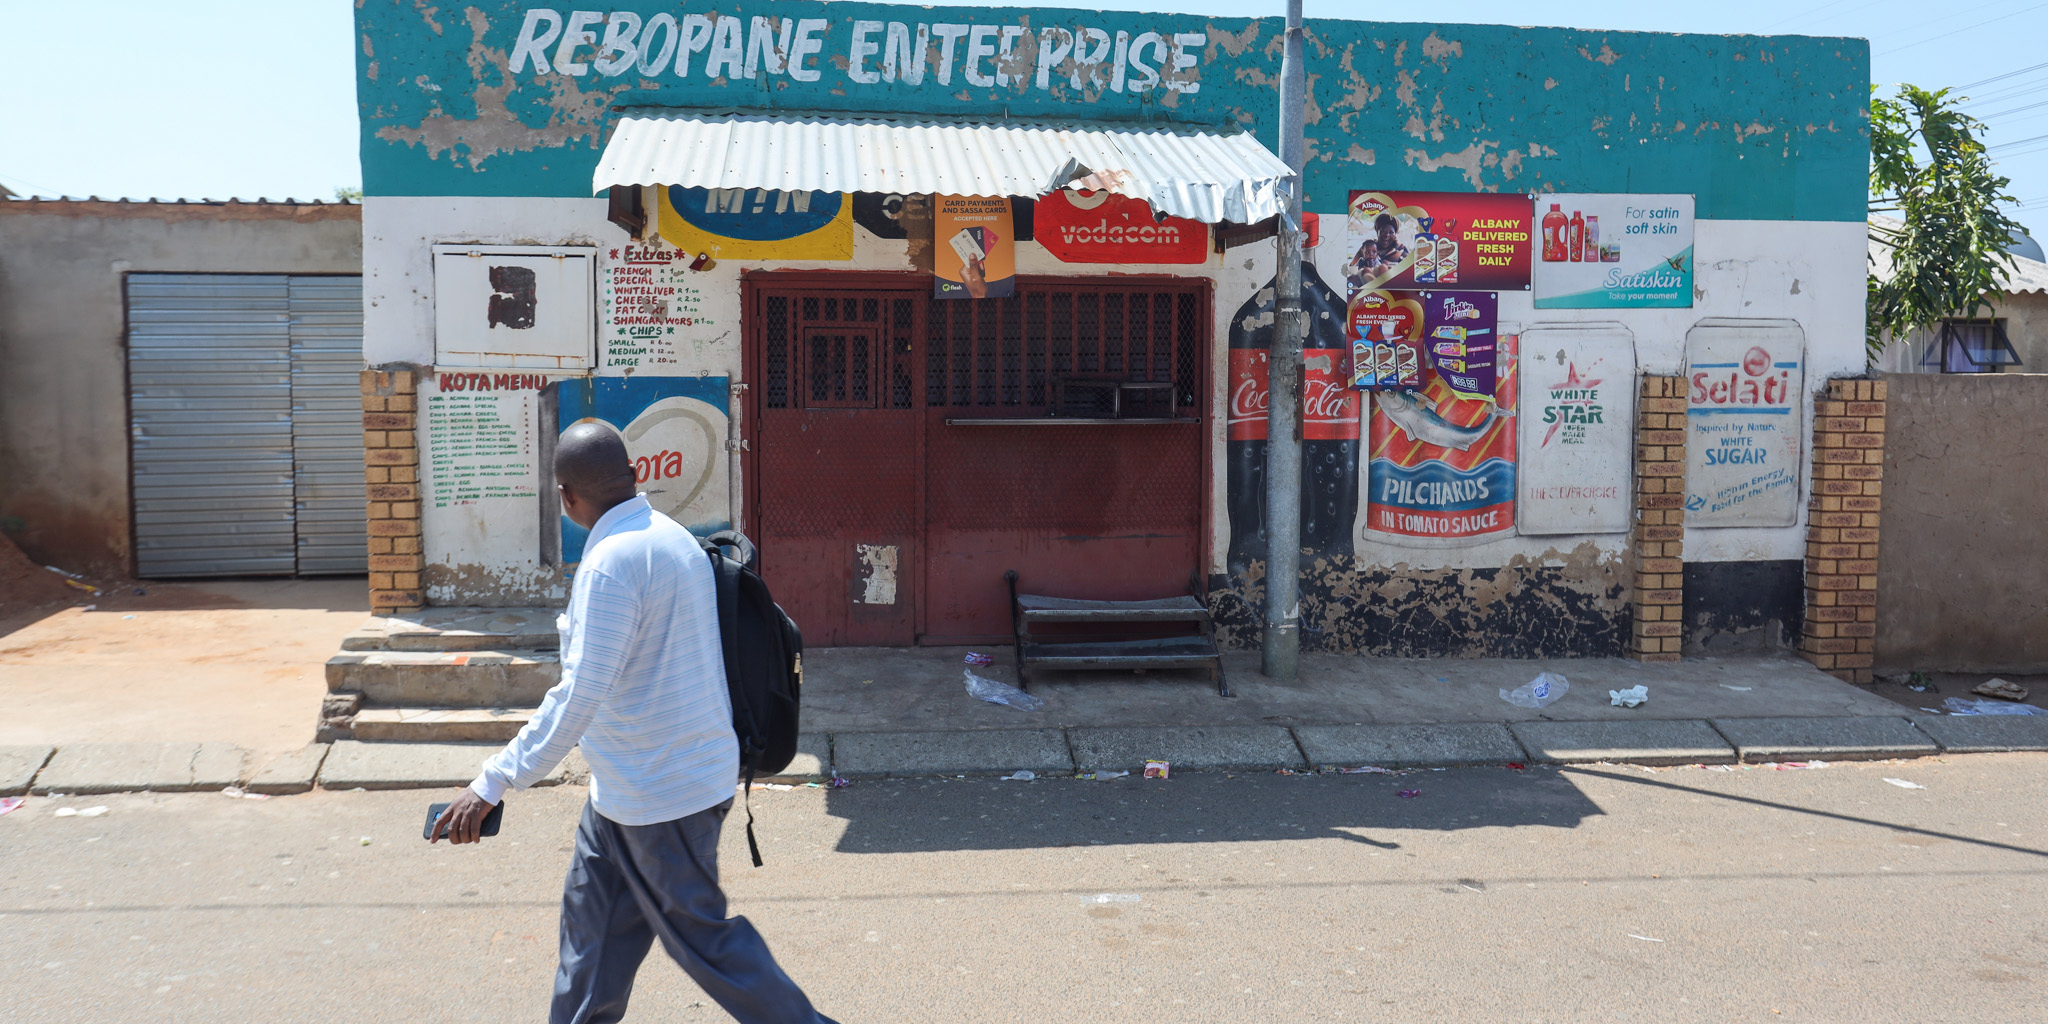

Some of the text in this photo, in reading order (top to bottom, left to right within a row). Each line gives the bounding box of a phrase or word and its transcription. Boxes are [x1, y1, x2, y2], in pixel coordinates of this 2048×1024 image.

[508, 8, 827, 82] REBOPANE
[705, 187, 812, 214] MN
[1361, 201, 1385, 211] Albany
[1625, 206, 1680, 219] For satin
[1471, 219, 1520, 230] ALBANY
[1625, 223, 1678, 234] soft skin
[1061, 218, 1180, 244] vodacom
[1463, 231, 1529, 243] DELIVERED
[624, 245, 673, 262] Extras
[1476, 244, 1515, 254] FRESH
[1478, 257, 1512, 267] DAILY
[613, 267, 652, 276] FRENCH
[613, 276, 654, 285] SPECIAL
[1603, 268, 1683, 289] Satiskin
[615, 296, 658, 305] CHEESE
[1363, 296, 1386, 305] Albany
[1627, 293, 1645, 302] your
[615, 306, 637, 315] FAT
[629, 326, 662, 336] CHIPS
[608, 348, 647, 356] MEDIUM
[607, 358, 640, 367] LARGE
[440, 373, 547, 392] KOTA MENU
[1691, 371, 1788, 405] Selati
[1231, 379, 1345, 417] Cocola
[1551, 390, 1598, 400] WHITE
[1542, 405, 1604, 424] STAR
[1696, 422, 1777, 434] Inspired by Nature
[1720, 437, 1753, 446] WHITE
[1705, 448, 1767, 466] SUGAR
[1751, 468, 1785, 486] Energy
[1381, 477, 1490, 507] PILCHARDS
[1530, 488, 1546, 500] THE
[1582, 486, 1617, 499] CHOICE
[1712, 475, 1795, 513] Food for the Family
[1381, 510, 1499, 534] IN TOMATO SAUCE
